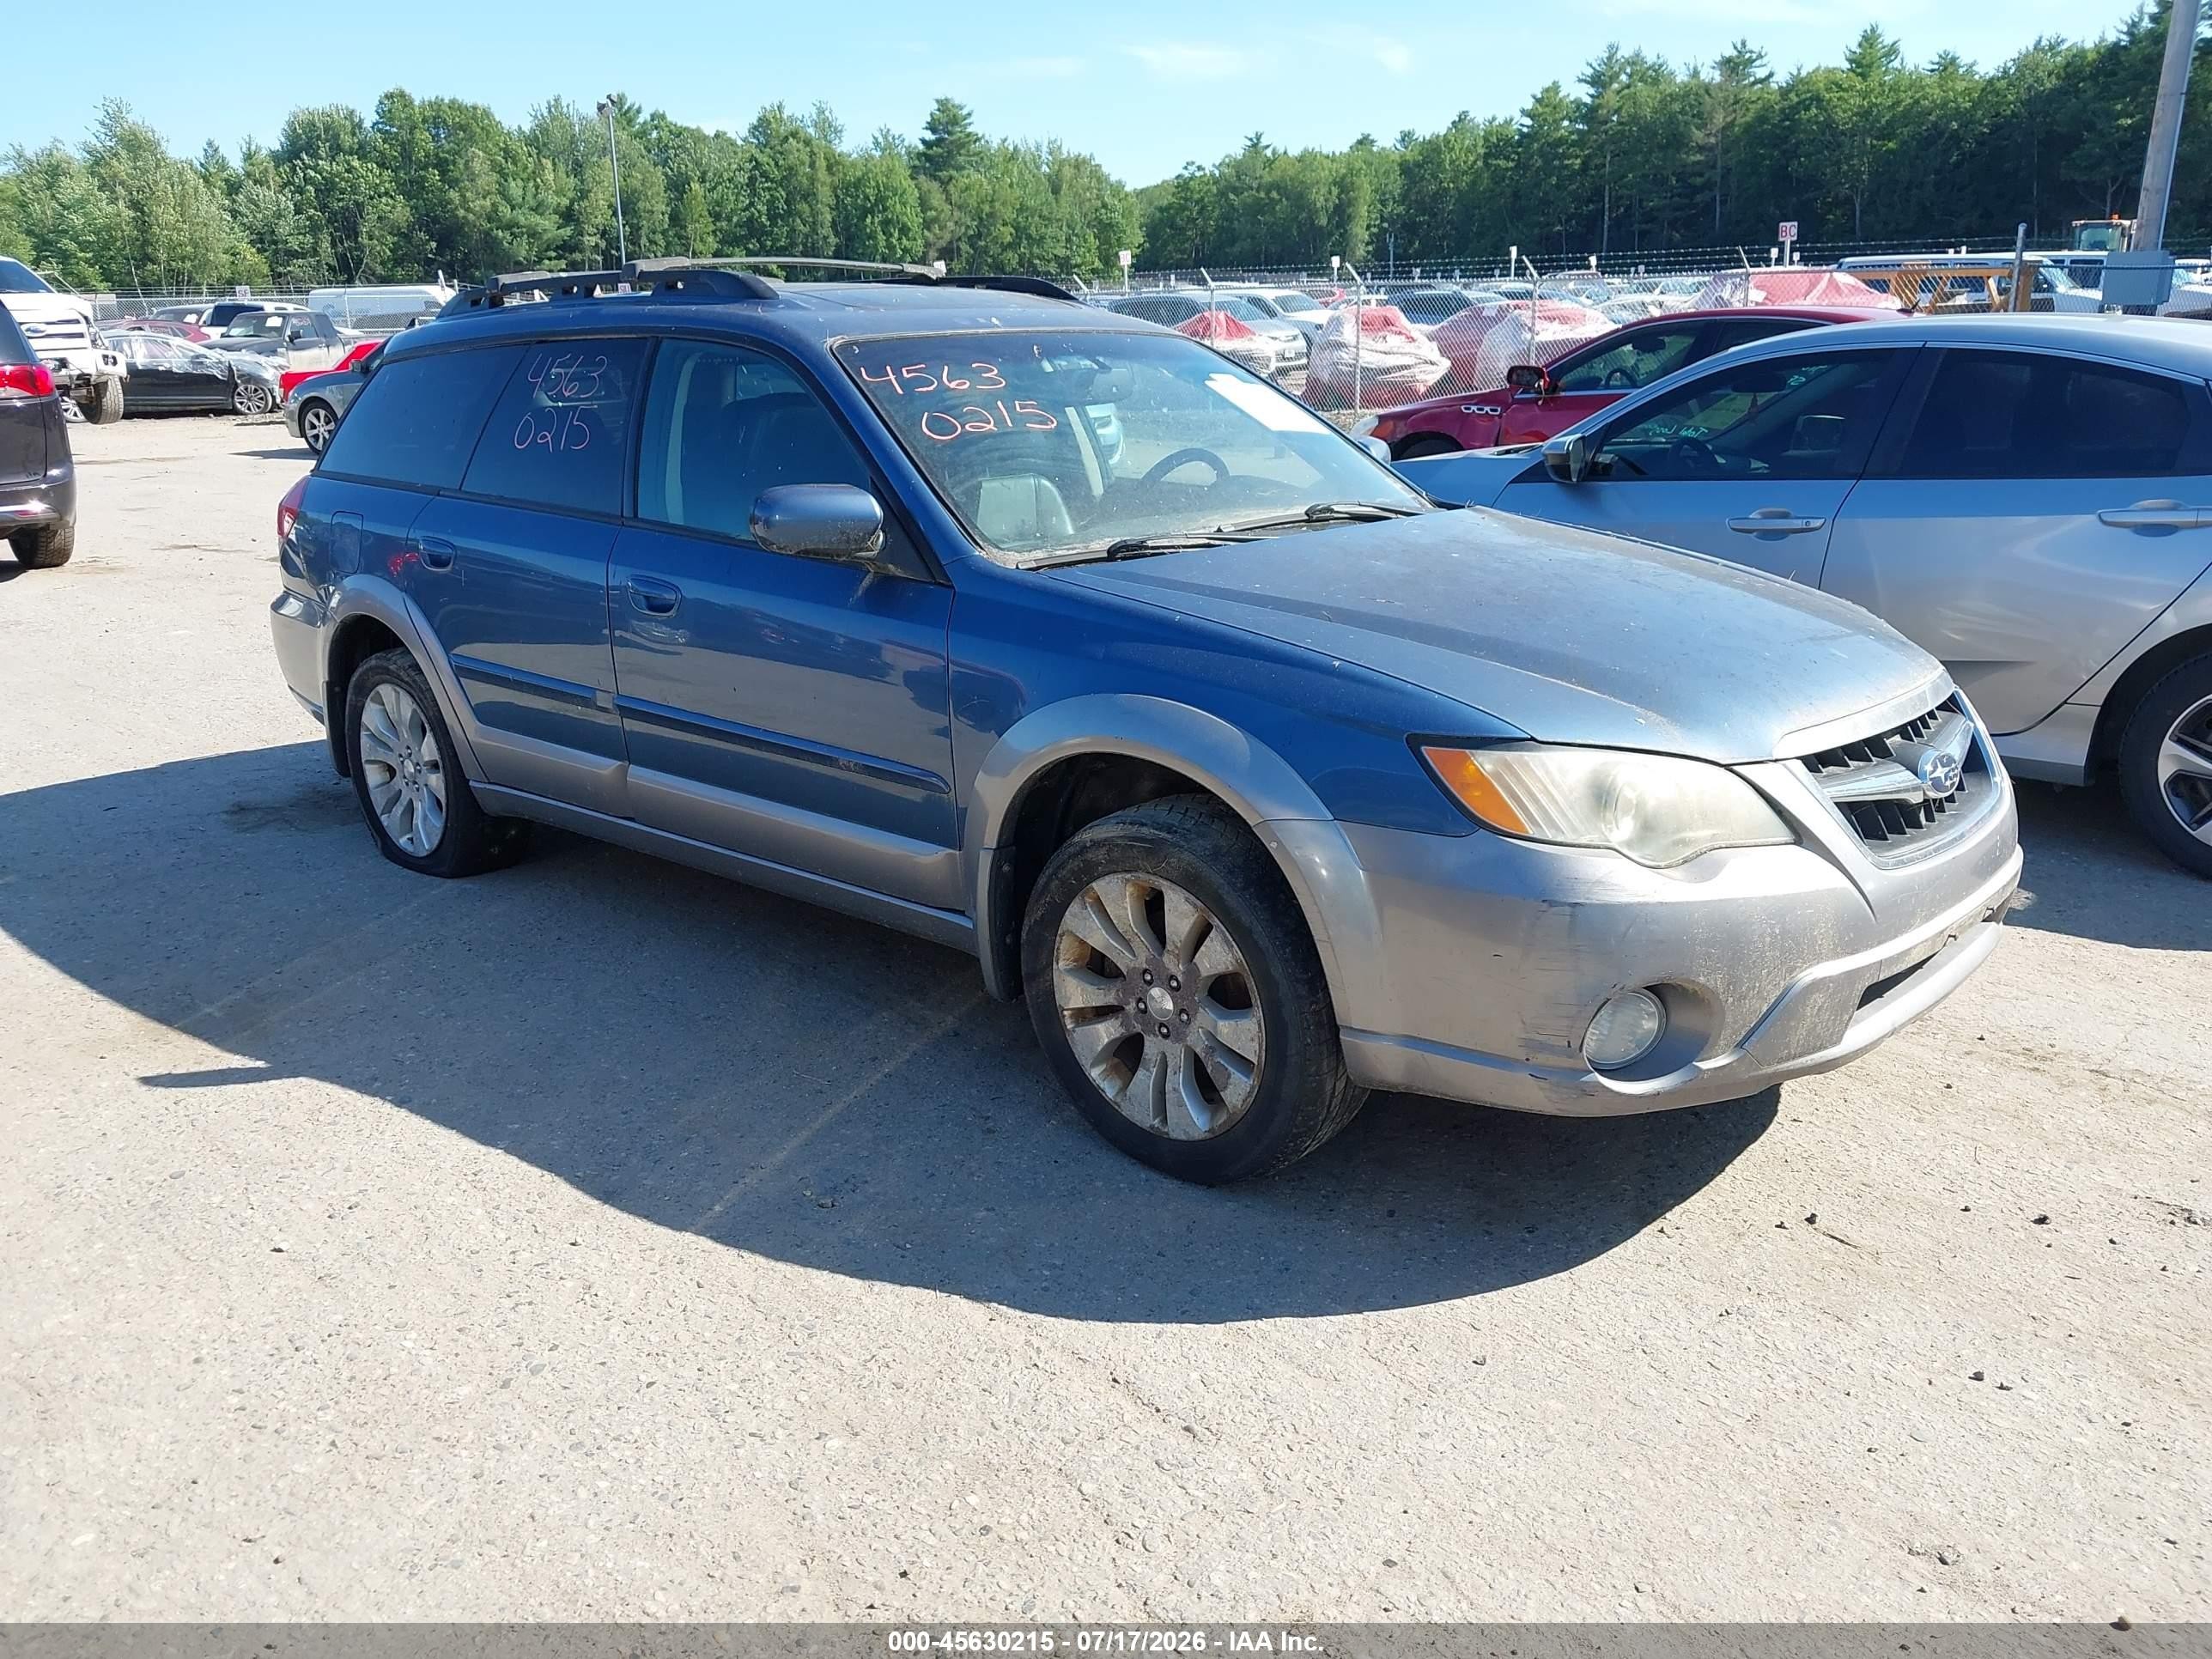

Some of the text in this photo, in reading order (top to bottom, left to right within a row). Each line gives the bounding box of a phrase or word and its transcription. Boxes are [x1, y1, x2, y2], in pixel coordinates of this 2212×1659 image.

[1780, 224, 1796, 238] BC
[527, 353, 608, 398] 4563
[860, 362, 1006, 395] 4563
[514, 404, 599, 453] 0215
[921, 399, 1058, 441] 0215
